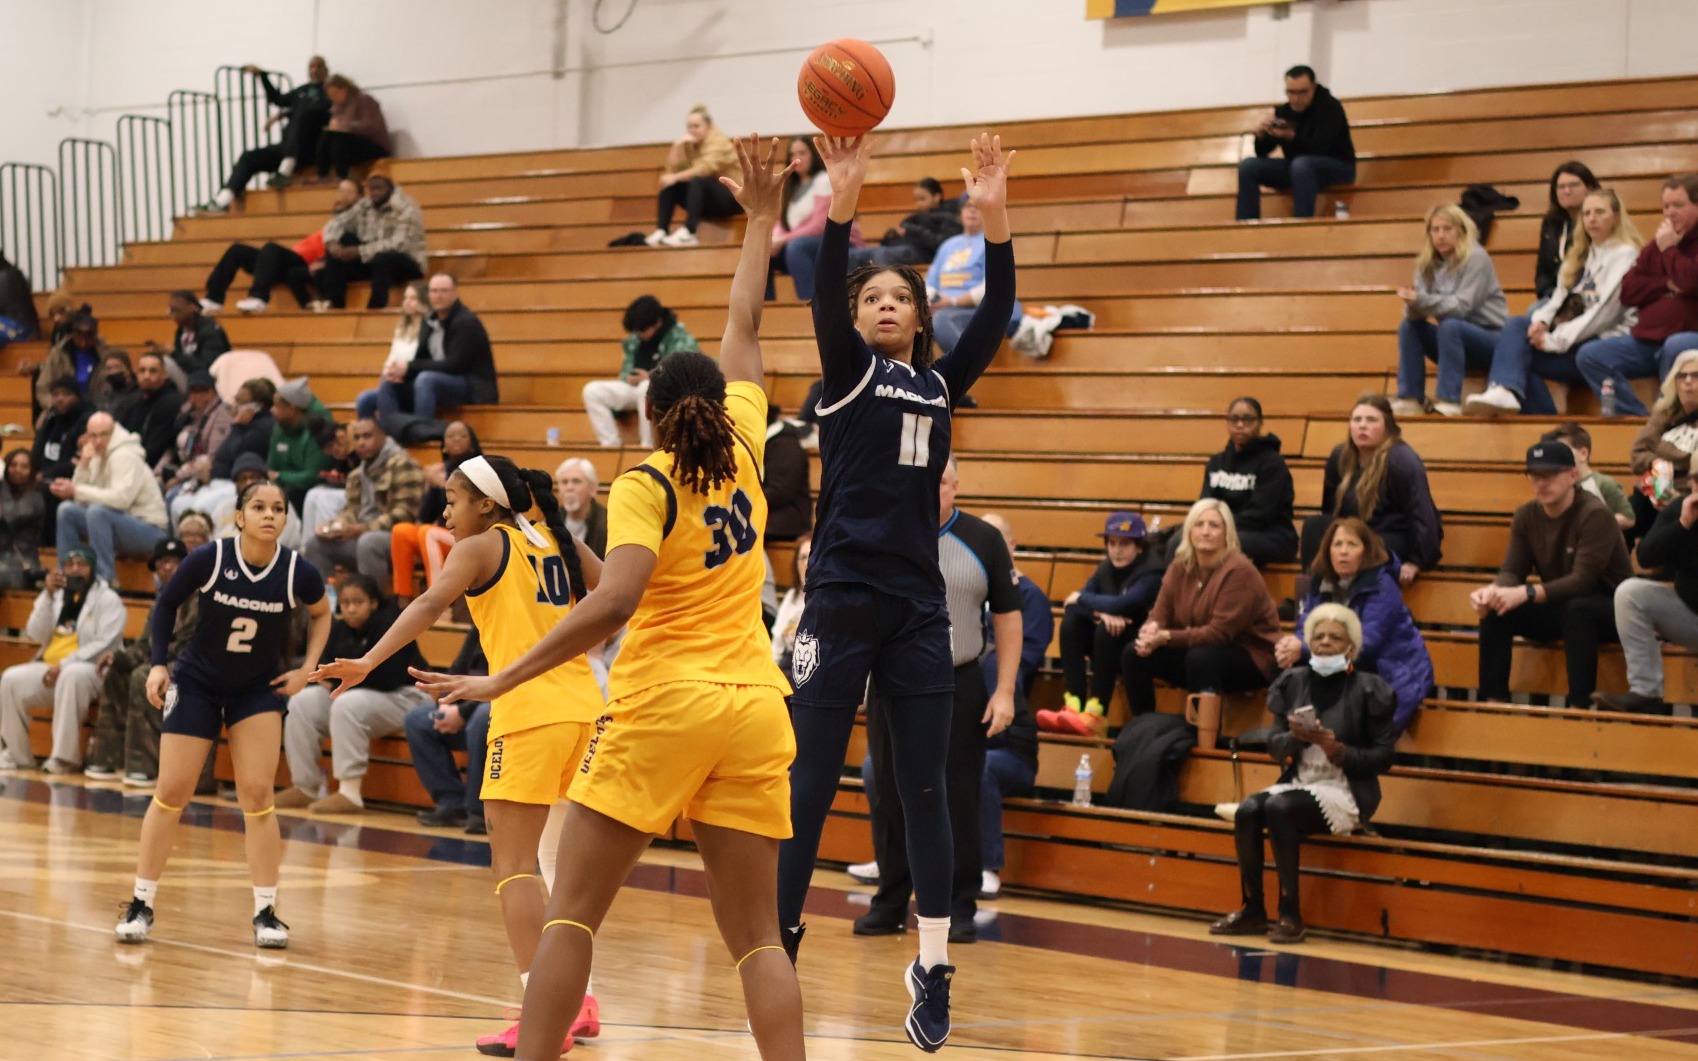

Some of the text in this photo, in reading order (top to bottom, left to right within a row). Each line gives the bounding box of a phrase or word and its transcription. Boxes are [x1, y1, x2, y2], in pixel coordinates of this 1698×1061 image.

[804, 74, 848, 115] LEGACY
[875, 384, 947, 408] MAC
[898, 412, 933, 467] 11
[703, 488, 758, 569] 30
[213, 590, 284, 613] MACOMB
[526, 554, 571, 607] 10
[226, 616, 258, 653] 2
[490, 736, 504, 779] OCELO
